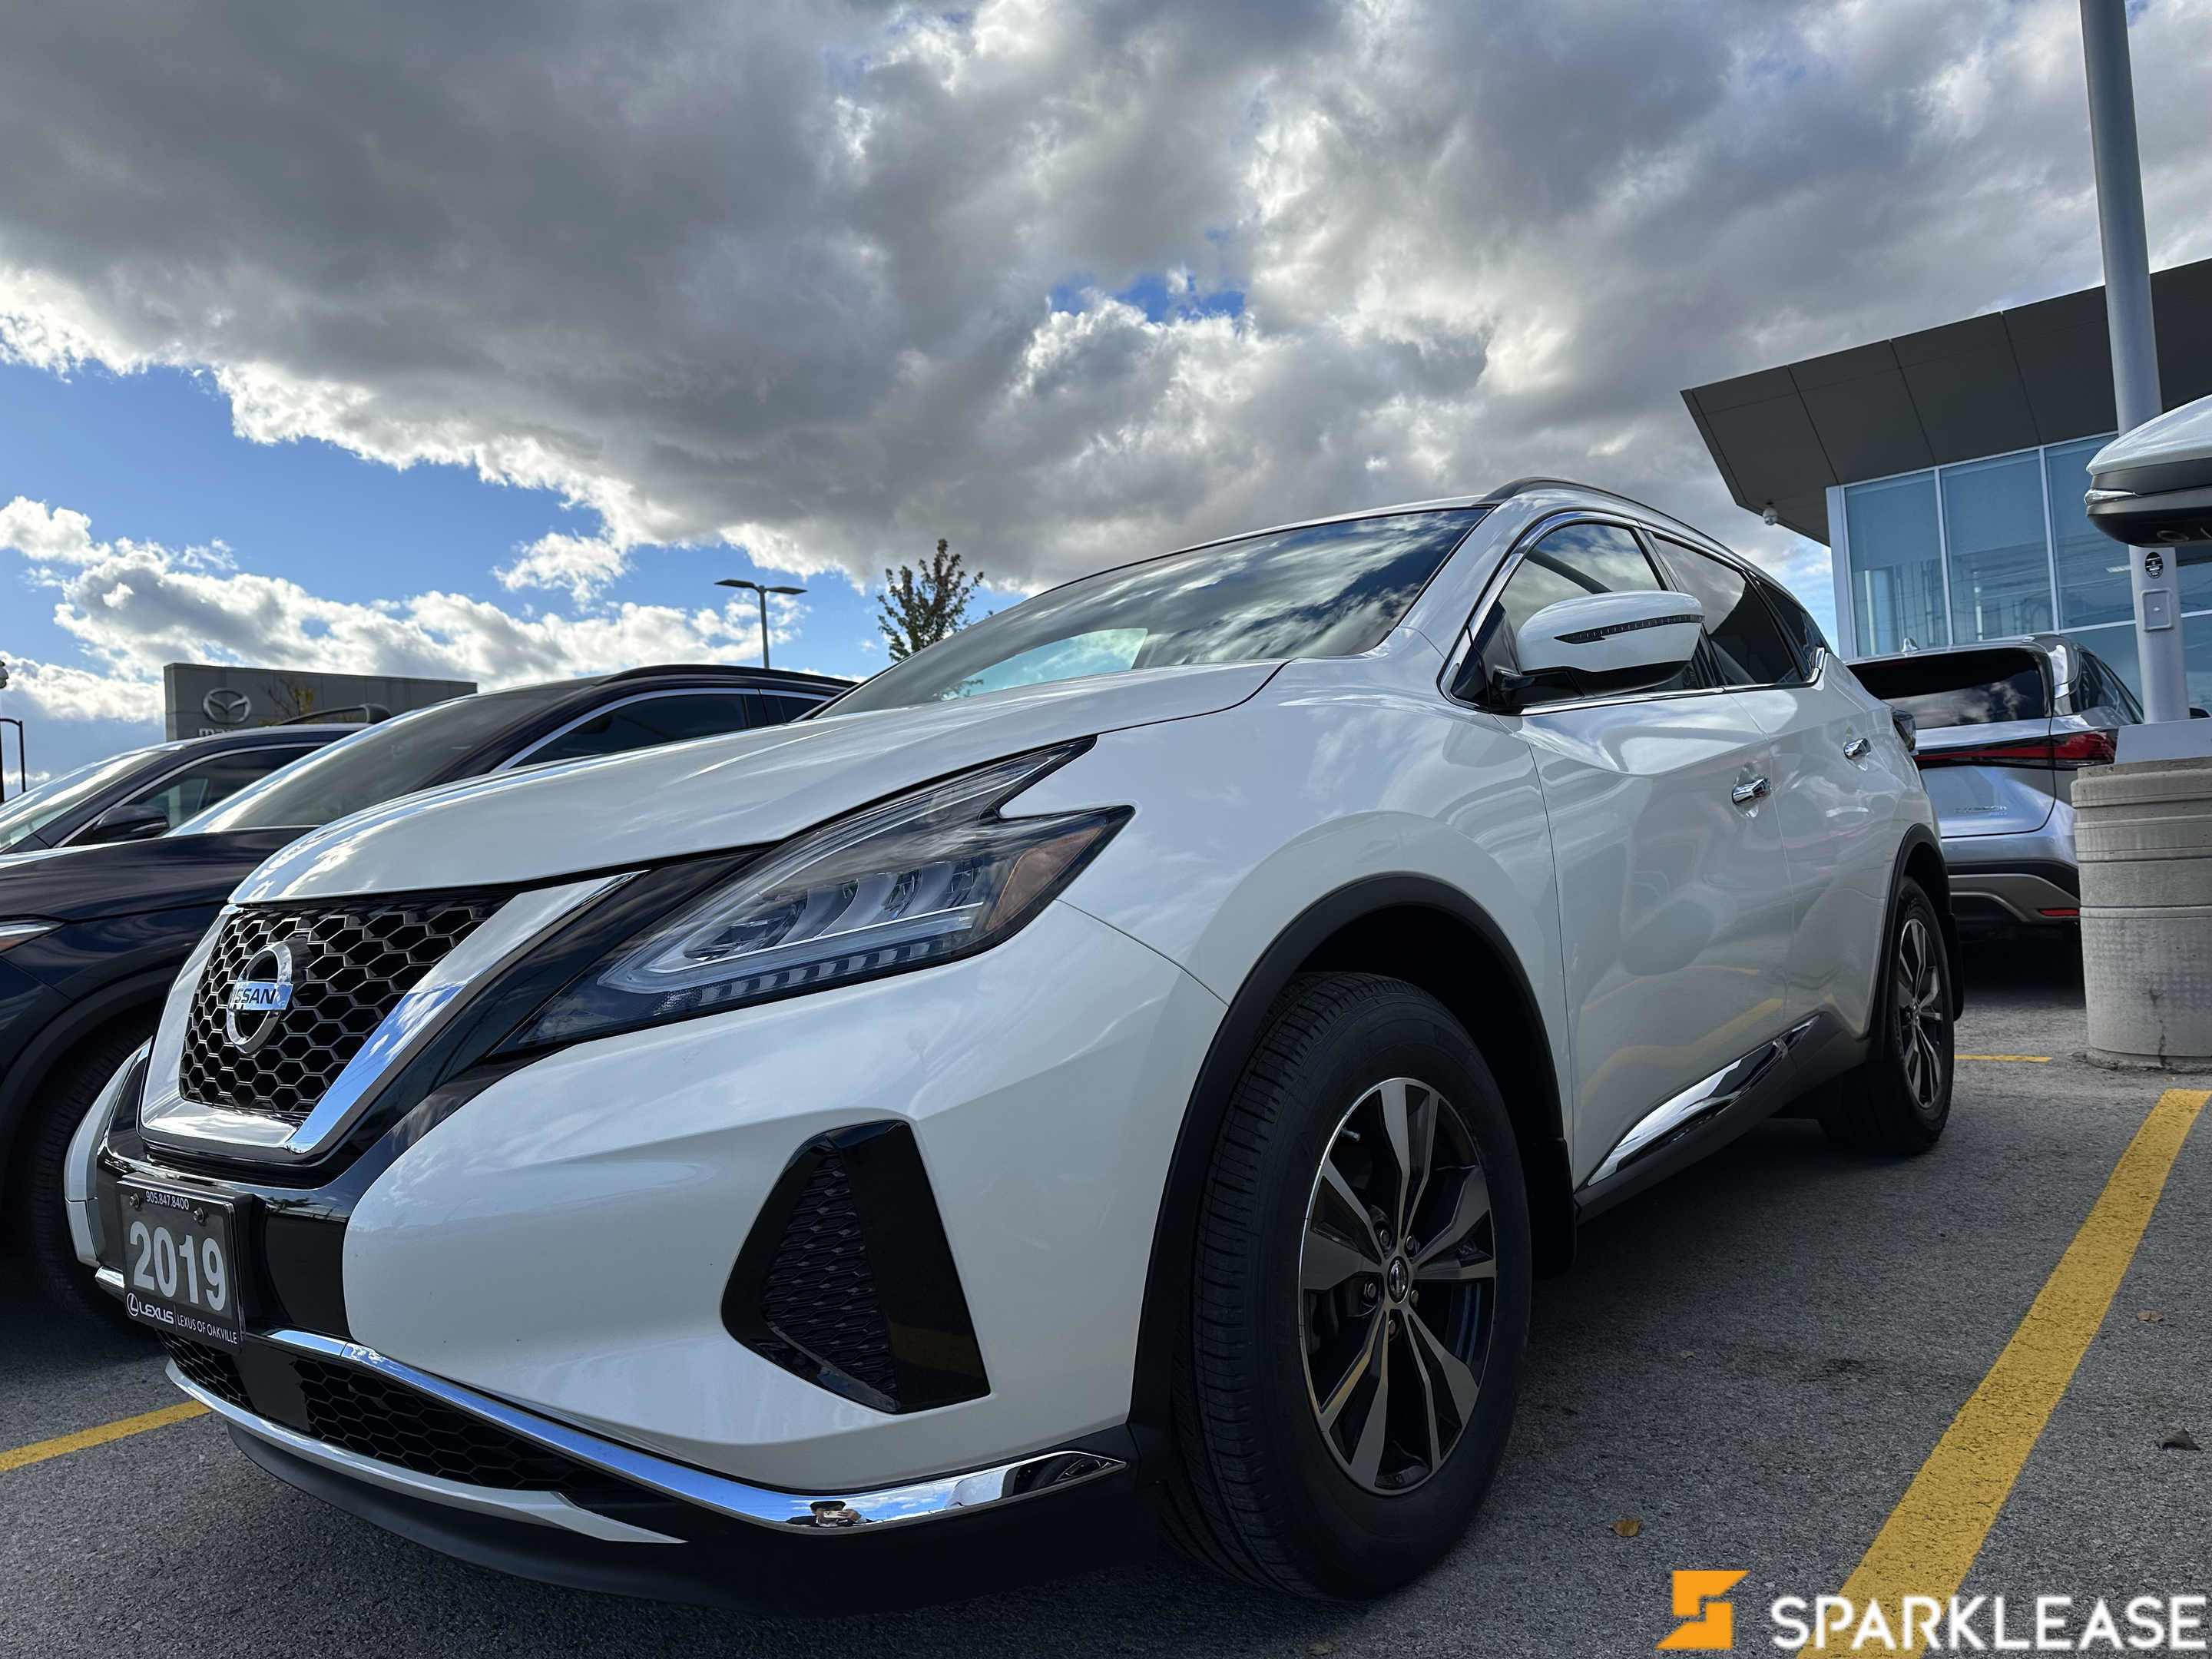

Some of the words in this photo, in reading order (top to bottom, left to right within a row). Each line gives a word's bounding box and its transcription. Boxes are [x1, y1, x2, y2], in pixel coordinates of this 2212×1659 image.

[146, 1190, 189, 1210] 905.847.8400
[130, 1221, 226, 1311] 2019
[139, 1302, 174, 1324] LEXUS
[177, 1314, 196, 1330] LEXUS
[197, 1320, 206, 1333] OF
[207, 1324, 238, 1344] OAKVILLE
